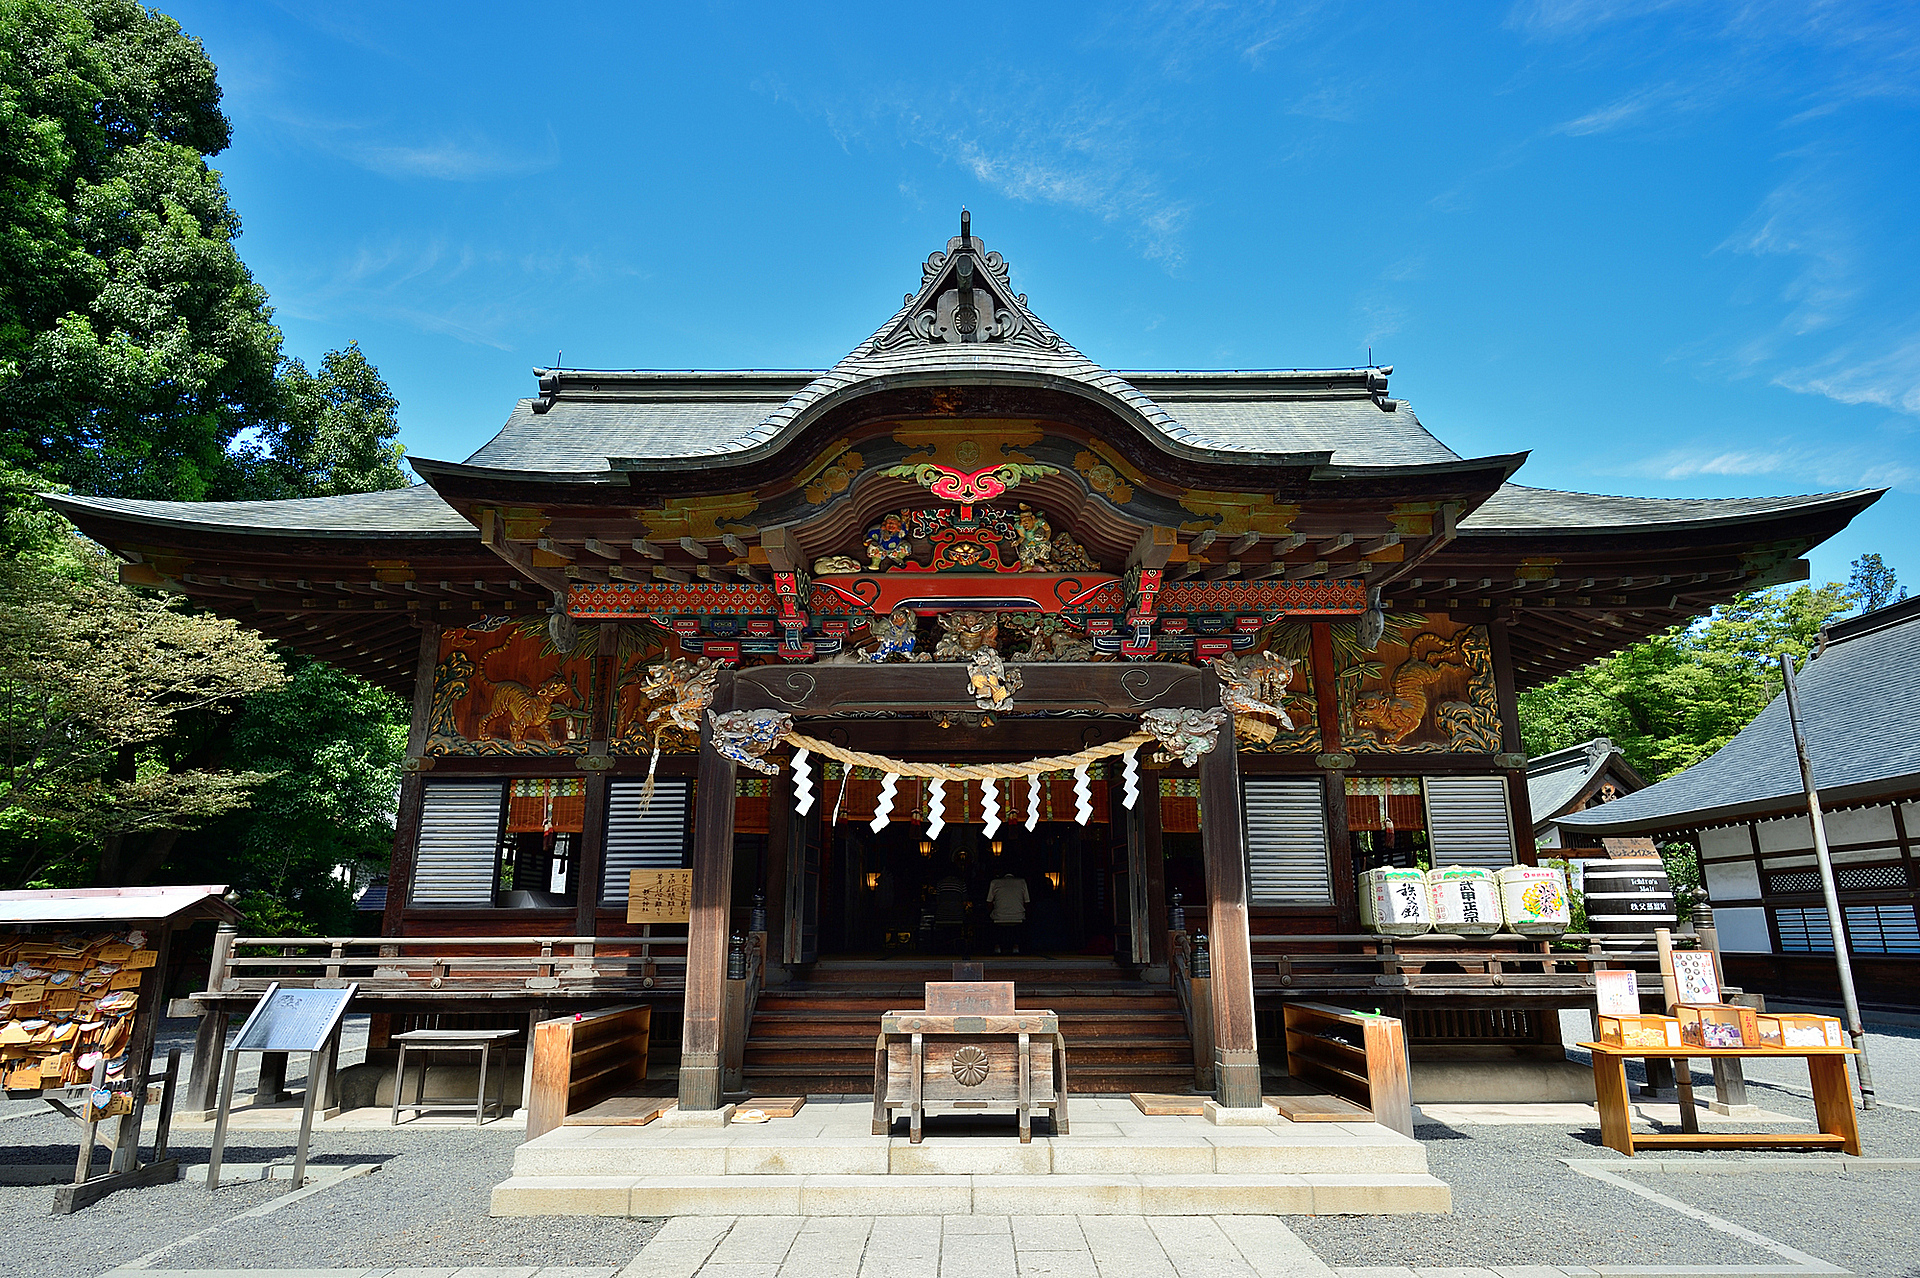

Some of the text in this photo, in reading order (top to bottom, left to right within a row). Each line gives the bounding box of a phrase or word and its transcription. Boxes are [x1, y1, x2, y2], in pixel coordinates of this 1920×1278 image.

[1459, 880, 1480, 923] 武甲正宗
[1744, 1015, 1755, 1042] おみくじ
